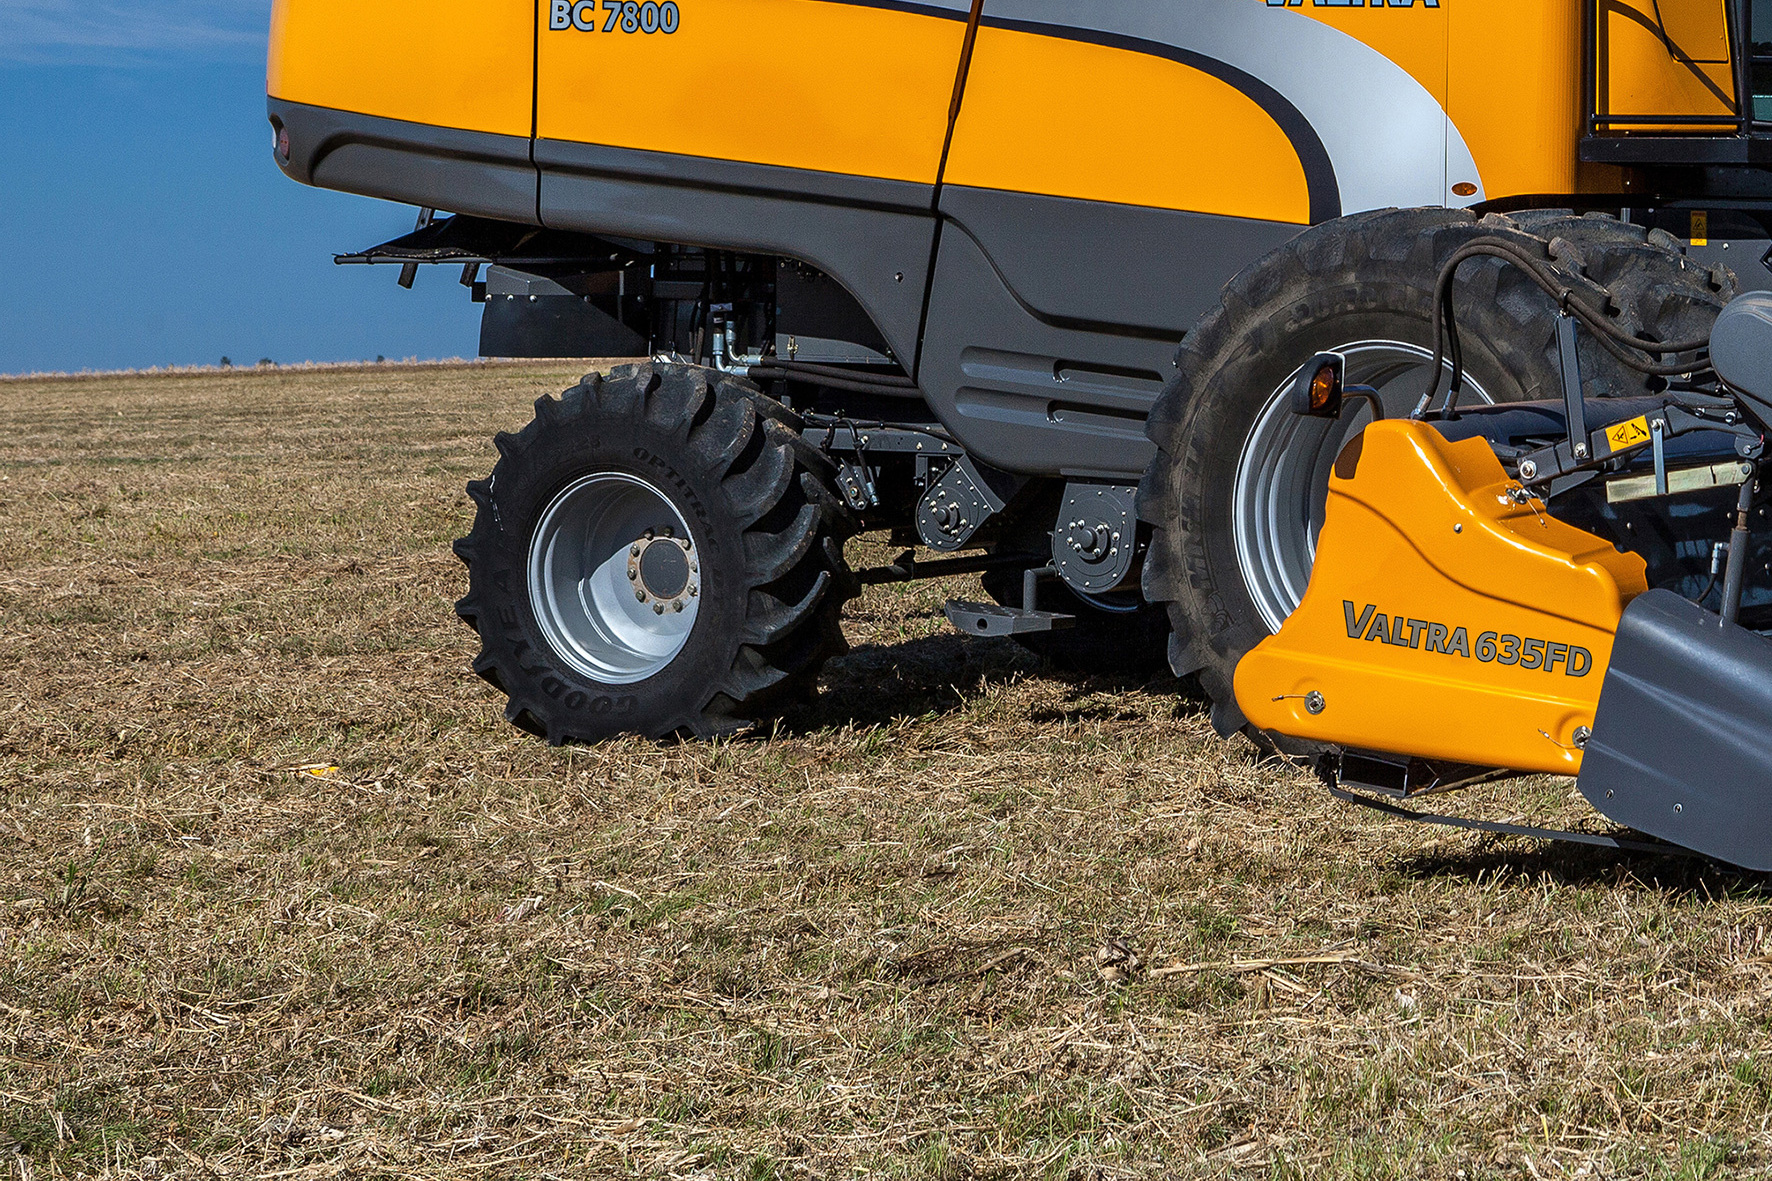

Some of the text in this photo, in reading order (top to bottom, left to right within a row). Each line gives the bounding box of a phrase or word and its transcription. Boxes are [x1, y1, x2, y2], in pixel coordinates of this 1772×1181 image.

[601, 0, 680, 35] 7800
[1342, 599, 1593, 678] VALTRA 635FD
